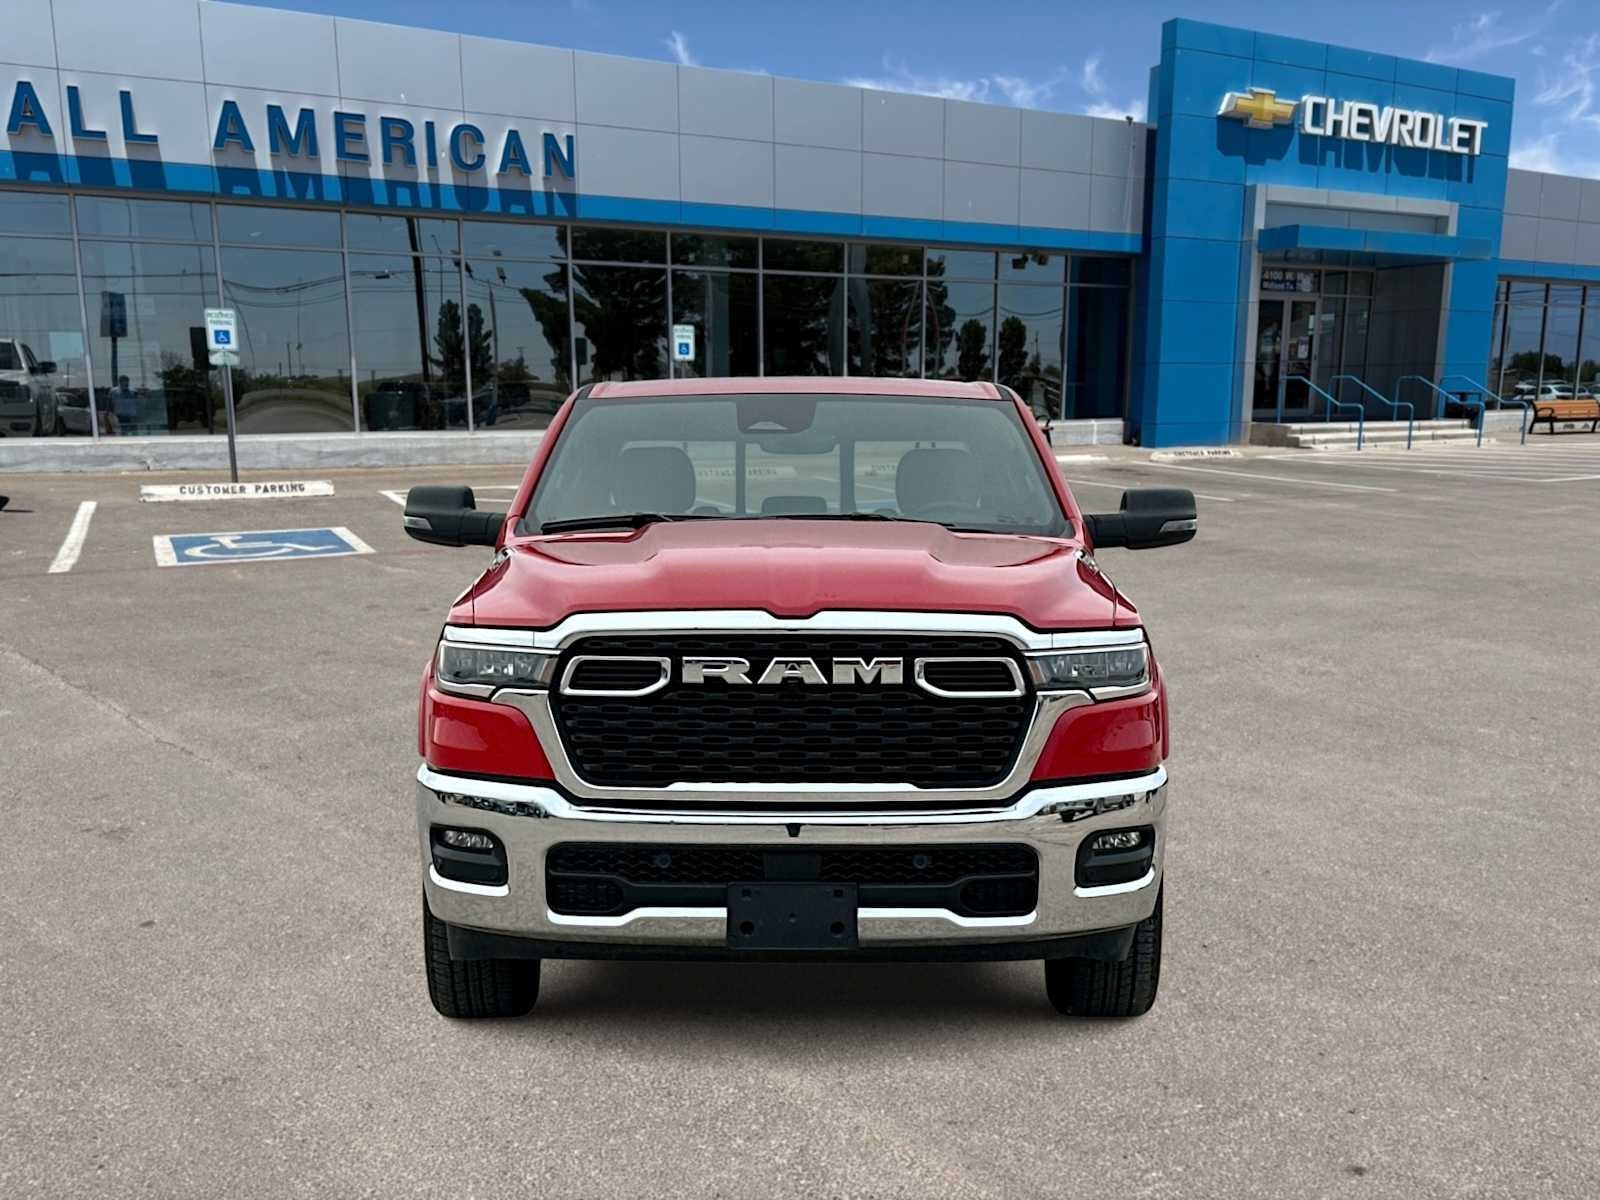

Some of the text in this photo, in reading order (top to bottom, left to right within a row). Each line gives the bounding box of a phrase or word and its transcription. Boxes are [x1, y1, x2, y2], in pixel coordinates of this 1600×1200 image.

[7, 80, 576, 180] ALL AMERICAN
[1301, 94, 1488, 156] CHEVROLET
[179, 482, 306, 496] CUSTOMER PARKING
[682, 656, 903, 684] RAM
